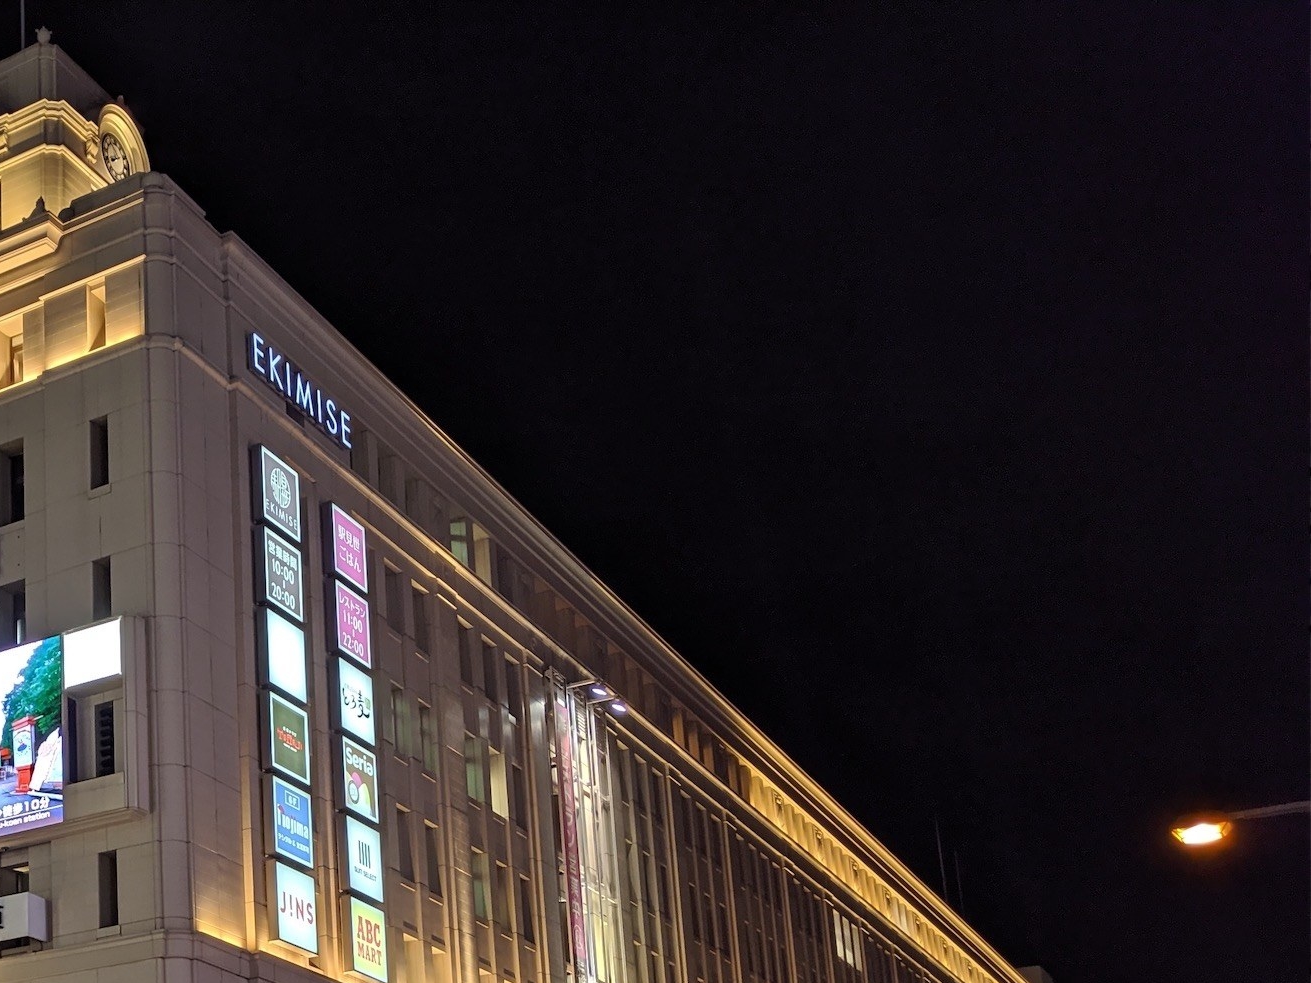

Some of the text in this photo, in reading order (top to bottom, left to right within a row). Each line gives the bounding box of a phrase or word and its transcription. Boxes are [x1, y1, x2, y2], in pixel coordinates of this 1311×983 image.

[252, 332, 352, 450] EKIMISE
[265, 498, 298, 530] EKIMISE
[338, 524, 360, 553] 駅見世
[268, 539, 298, 571] 営業時間
[339, 545, 361, 573] ごはん
[271, 558, 295, 585] 10:00
[271, 582, 296, 610] 20:00
[339, 592, 366, 618] レストラン
[342, 609, 363, 634] 11:00
[342, 631, 364, 657] 22:00
[346, 746, 373, 776] Seria
[23, 811, 51, 823] station
[357, 915, 381, 948] ABC
[357, 940, 382, 966] MART
